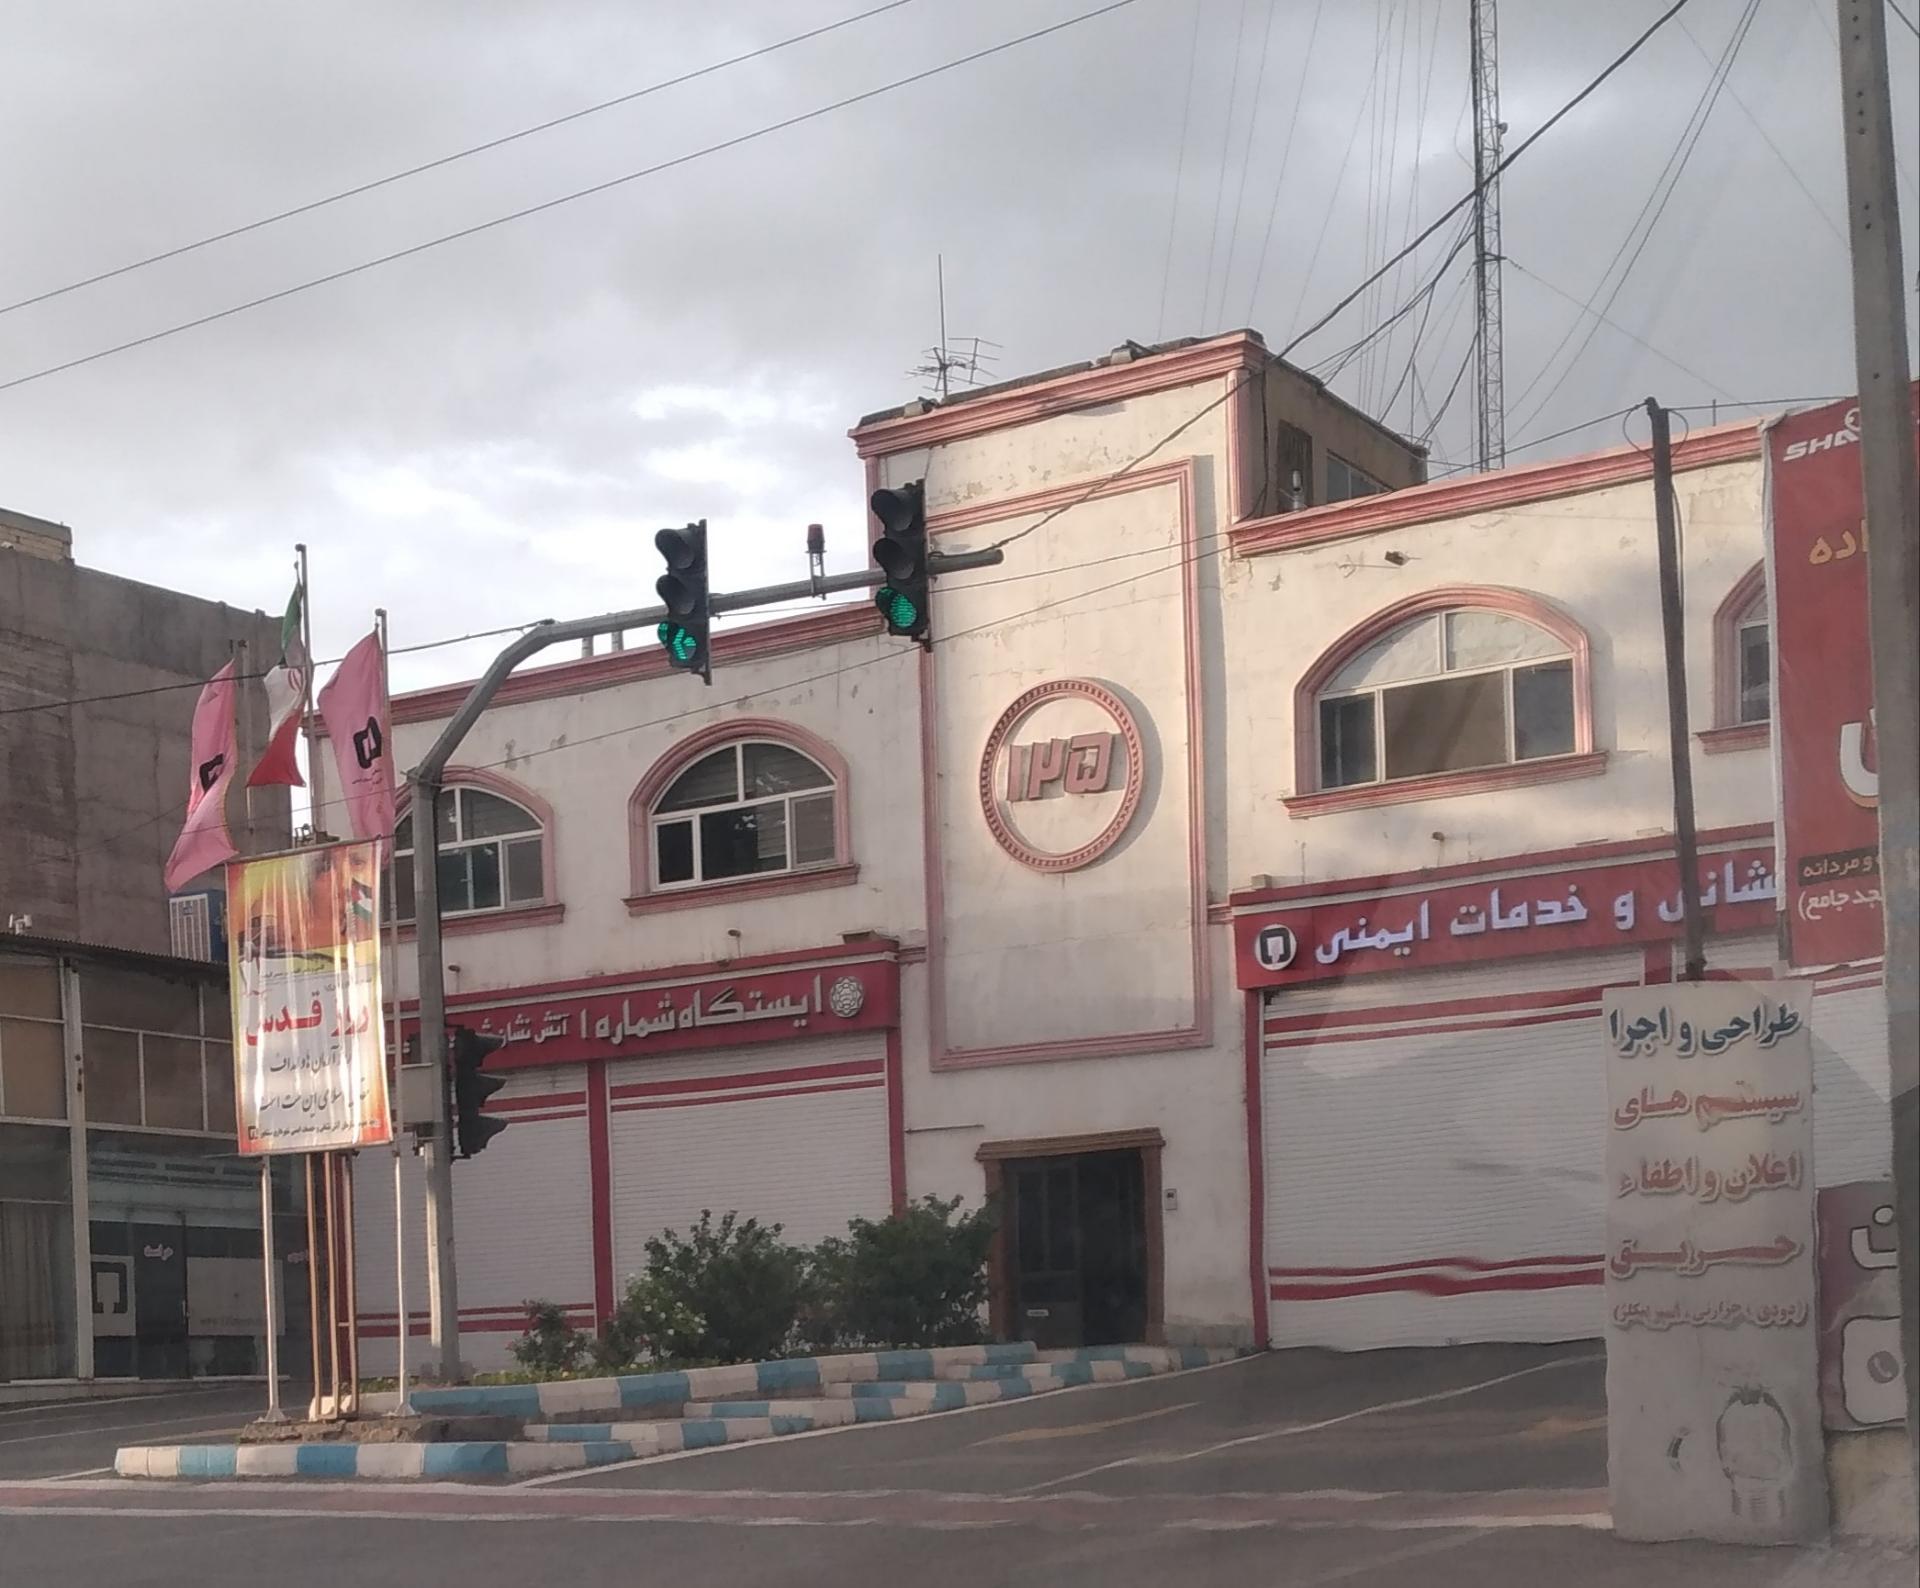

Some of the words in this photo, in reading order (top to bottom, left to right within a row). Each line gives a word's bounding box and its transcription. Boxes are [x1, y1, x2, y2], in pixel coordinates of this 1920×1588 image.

[1783, 428, 1861, 462] SHA
[1809, 518, 1869, 565] اده
[1450, 884, 1587, 937] خدمات
[1614, 890, 1635, 931] و
[1658, 859, 1777, 923] شانی
[1315, 900, 1430, 964] ایمنی
[246, 990, 323, 1047] قدس
[595, 991, 676, 1045] شماره
[679, 973, 823, 1029] ایستگاه
[499, 1013, 532, 1048] نشان
[533, 1010, 571, 1044] آتش
[1610, 1005, 1668, 1053] اجرا
[1678, 1020, 1694, 1053] و
[1702, 1002, 1801, 1052] طراحی
[1614, 1087, 1690, 1127] های
[1696, 1080, 1801, 1127] سیستم
[1618, 1156, 1694, 1198] اطفاء
[1703, 1168, 1718, 1198] و
[1725, 1151, 1798, 1196] اعلان
[1610, 1233, 1798, 1277] حریق
